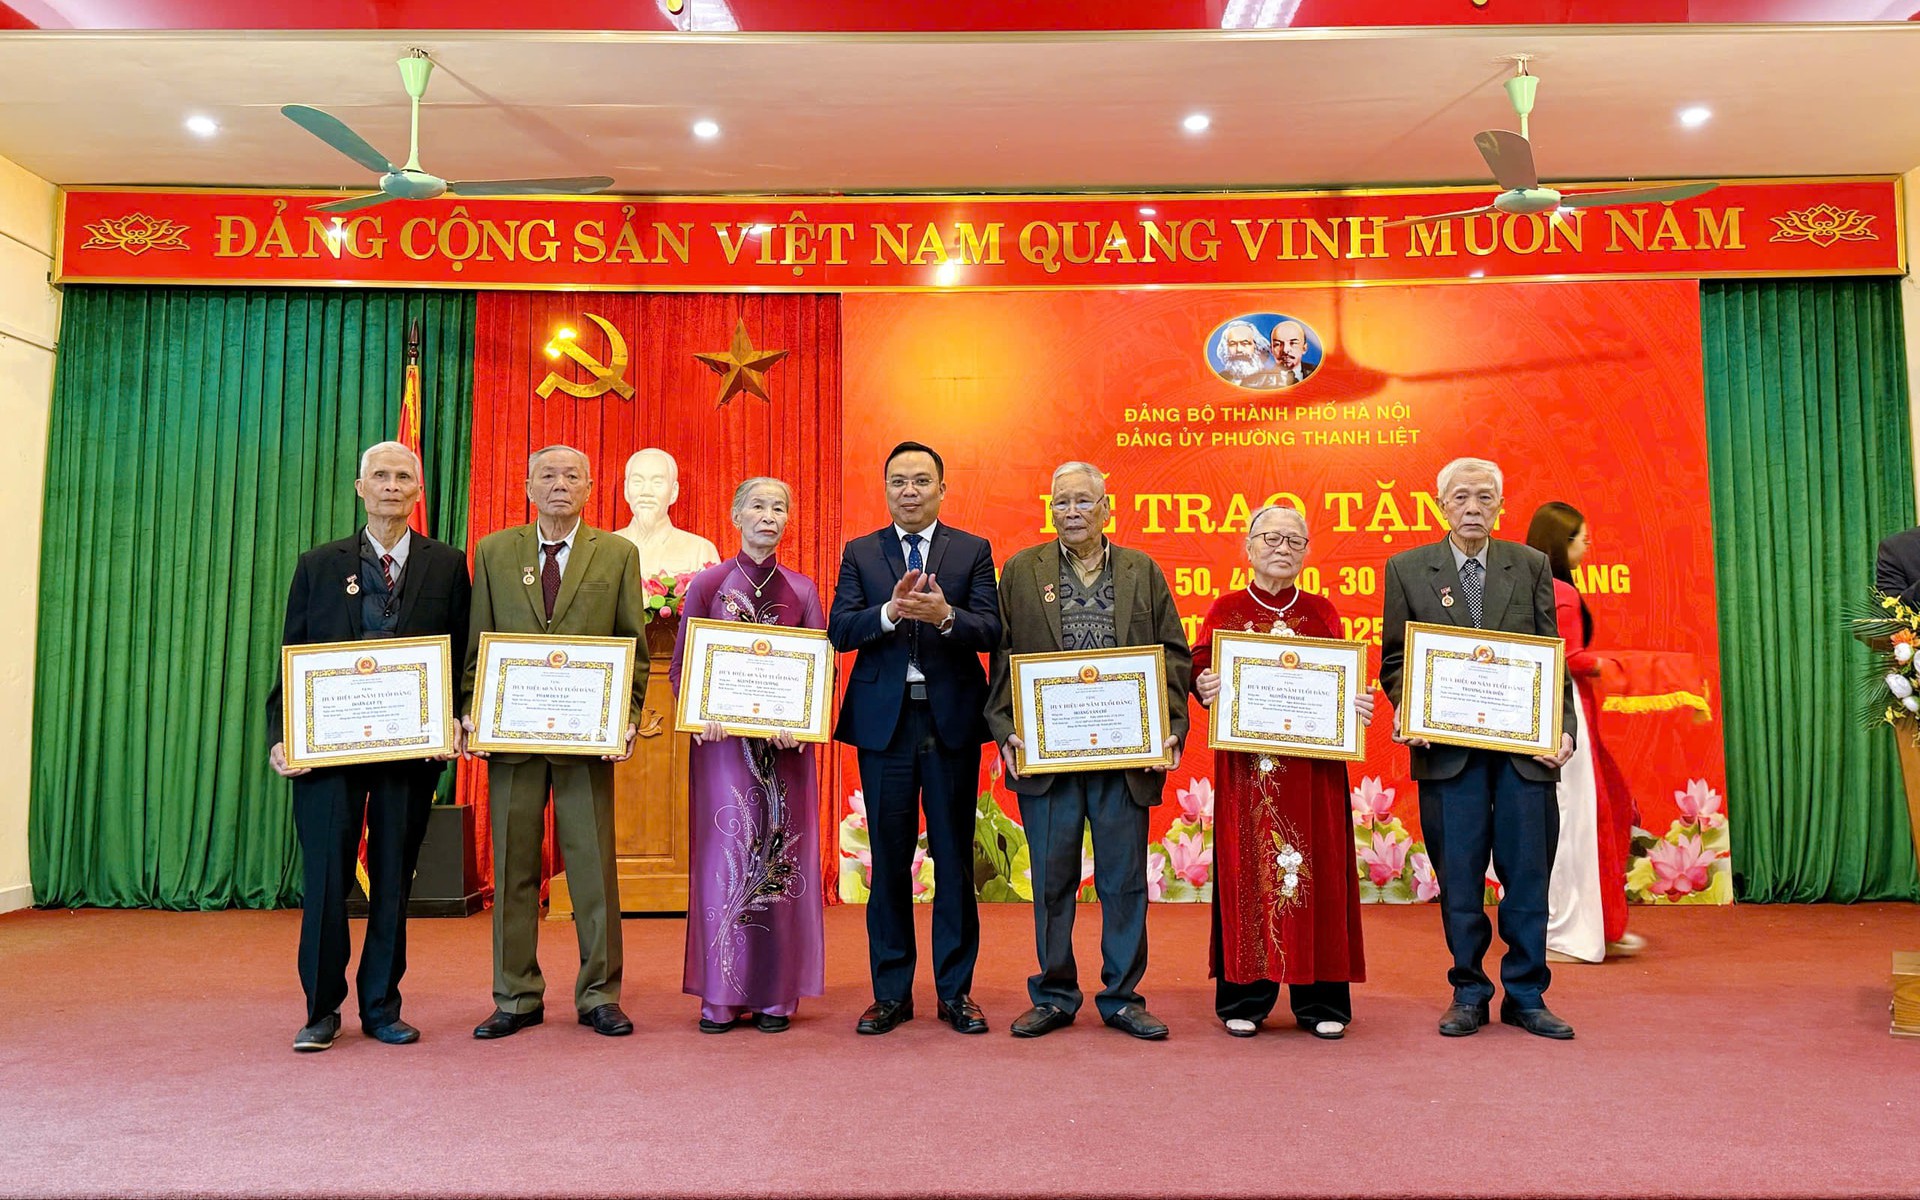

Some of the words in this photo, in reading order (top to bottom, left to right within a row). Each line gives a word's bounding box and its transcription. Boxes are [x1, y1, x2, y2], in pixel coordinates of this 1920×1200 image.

[214, 200, 388, 258] ĐẢNG
[400, 205, 561, 271] CỘNG
[573, 204, 690, 264] SẢN
[711, 210, 854, 276] VIỆT
[870, 221, 1006, 265] NAM
[1018, 219, 1222, 273] QUANG
[1231, 216, 1390, 261] VINH
[1125, 403, 1180, 423] ĐẢNG
[1187, 404, 1215, 425] BỘ
[1221, 403, 1287, 421] THÀNH
[1295, 401, 1338, 421] PHỐ
[1344, 402, 1369, 420] HÀ
[1376, 401, 1411, 423] NỘI
[1116, 427, 1172, 447] ĐẢNG
[1179, 427, 1204, 446] ỦY
[1212, 429, 1295, 446] PHƯỜNG
[1302, 430, 1370, 445] THANH
[1377, 426, 1420, 448] LIỆT
[1325, 479, 1505, 544] TẶN
[1175, 567, 1219, 599] 50,
[1339, 566, 1376, 595] 30
